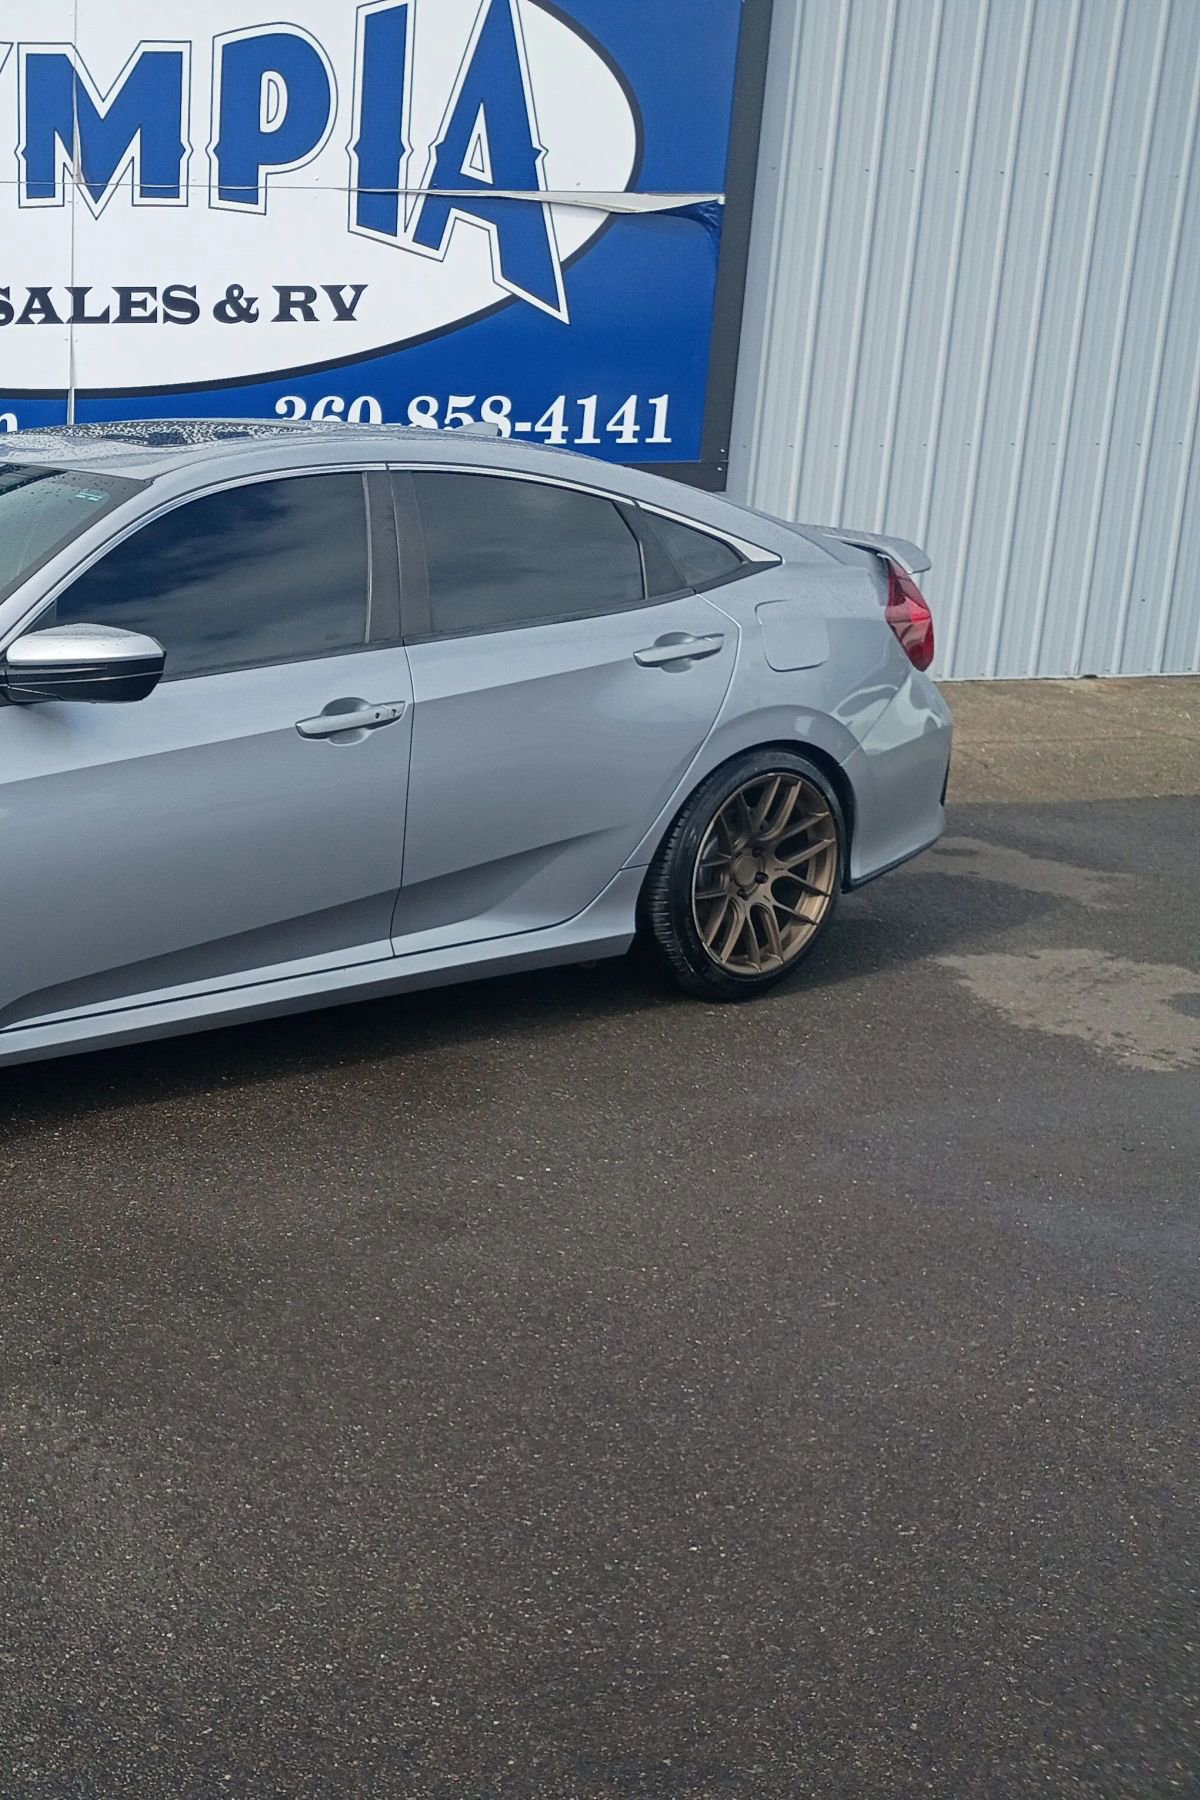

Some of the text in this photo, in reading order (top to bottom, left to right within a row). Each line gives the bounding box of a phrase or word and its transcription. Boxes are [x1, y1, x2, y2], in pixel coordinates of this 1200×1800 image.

[212, 284, 259, 324] &
[270, 284, 369, 323] RV
[274, 394, 672, 445] 360858-4141
